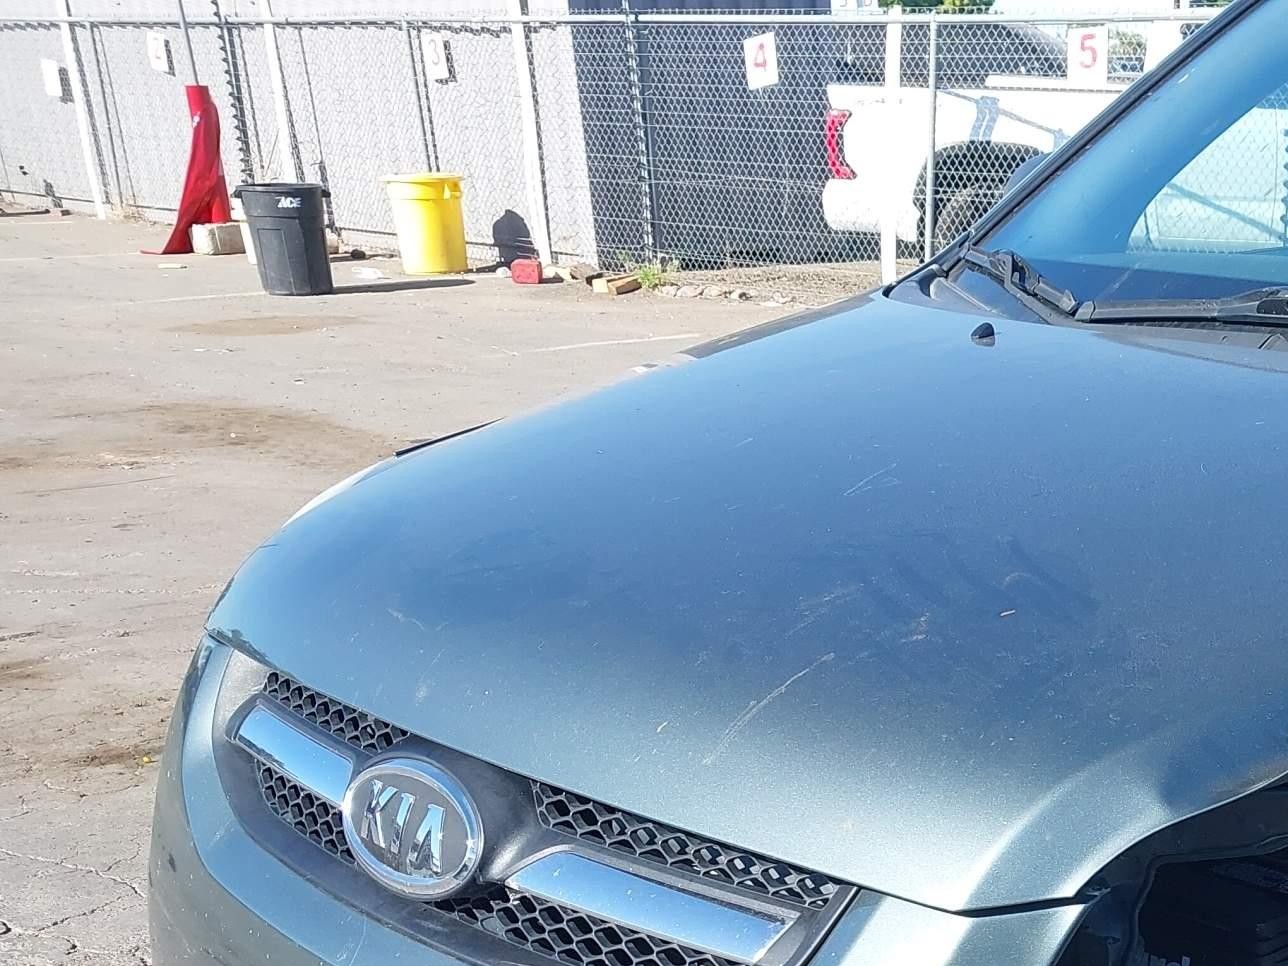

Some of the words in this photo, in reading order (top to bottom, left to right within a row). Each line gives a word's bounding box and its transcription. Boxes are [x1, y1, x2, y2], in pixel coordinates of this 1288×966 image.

[428, 38, 441, 66] 3
[753, 42, 768, 73] 4
[1080, 33, 1098, 69] 5
[275, 195, 302, 208] ACE
[360, 779, 447, 877] KIA
